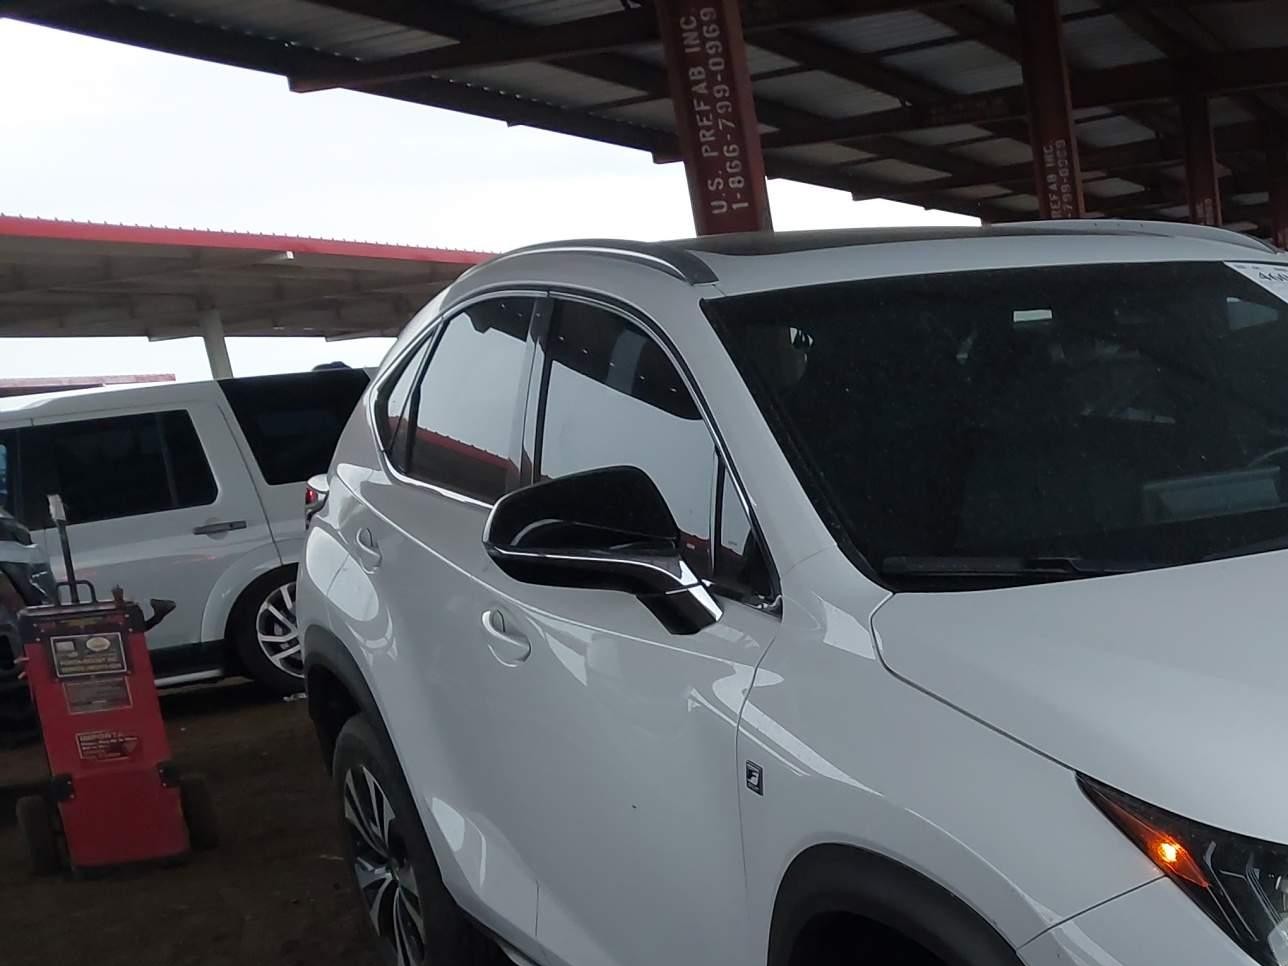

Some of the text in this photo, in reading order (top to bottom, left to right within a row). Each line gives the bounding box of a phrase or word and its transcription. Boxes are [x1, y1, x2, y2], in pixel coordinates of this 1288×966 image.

[688, 66, 719, 157] PREFAB
[700, 7, 749, 210] 1-866-799-0969
[707, 170, 728, 214] U.S.
